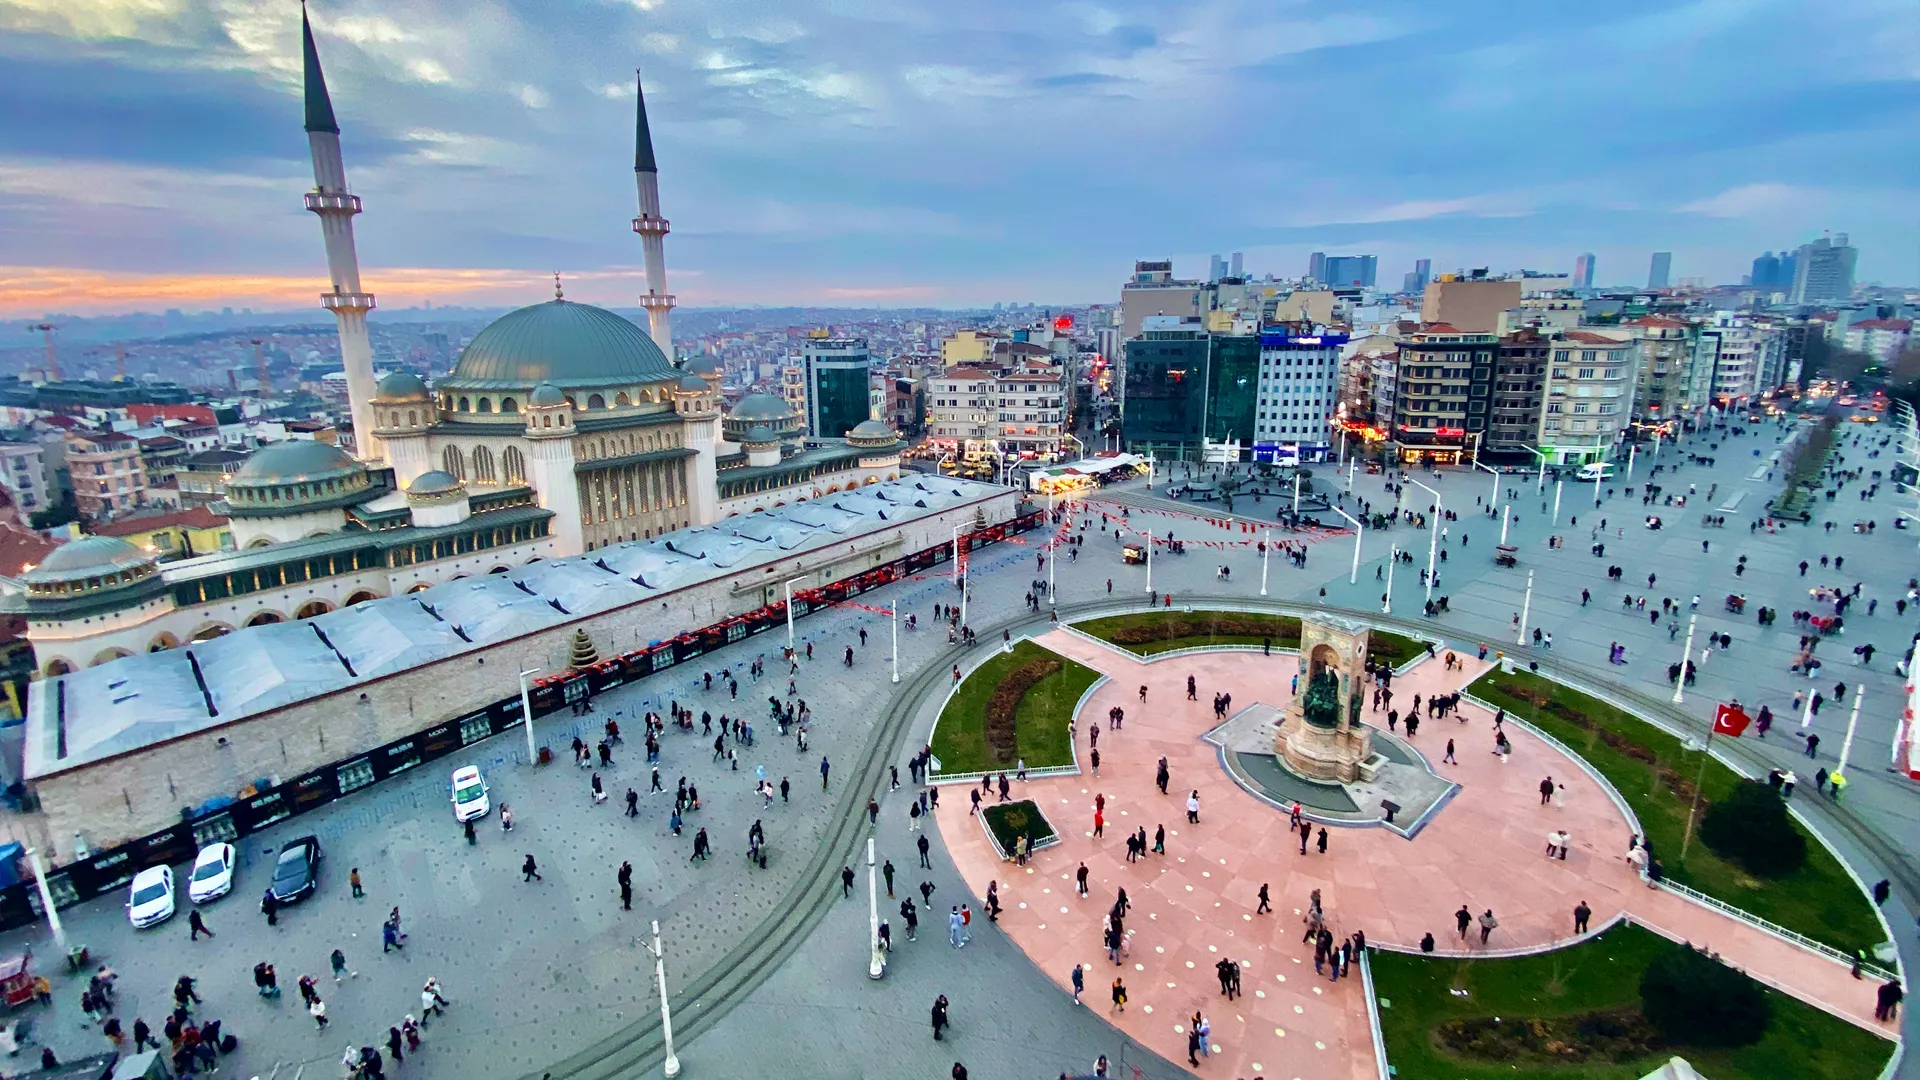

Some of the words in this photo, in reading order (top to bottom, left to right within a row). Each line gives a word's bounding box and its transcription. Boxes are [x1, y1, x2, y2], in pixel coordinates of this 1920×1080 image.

[536, 687, 553, 697] MODA
[428, 727, 448, 738] MODA
[299, 775, 322, 787] MODA
[148, 832, 175, 846] MODA
